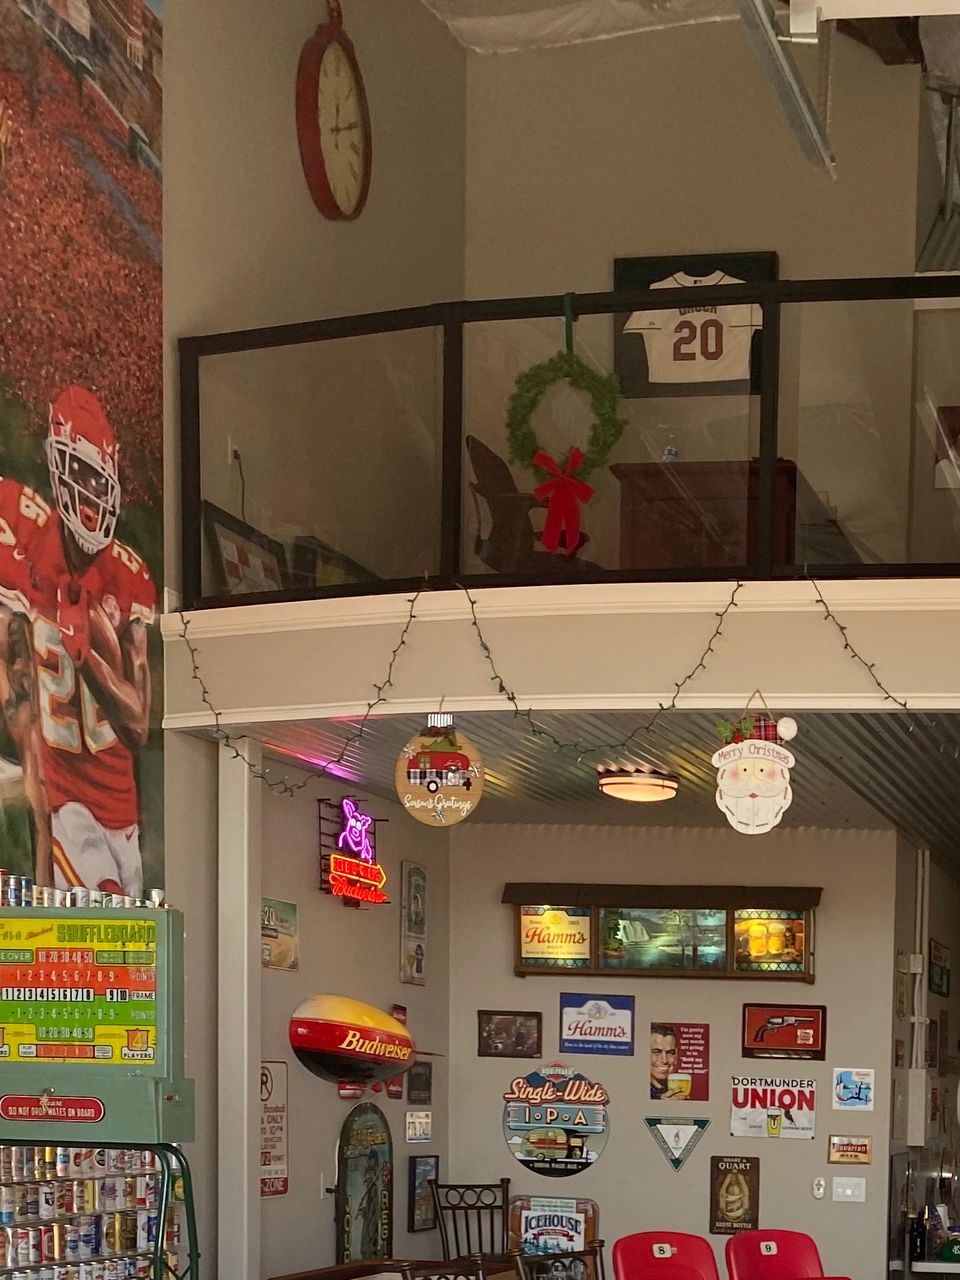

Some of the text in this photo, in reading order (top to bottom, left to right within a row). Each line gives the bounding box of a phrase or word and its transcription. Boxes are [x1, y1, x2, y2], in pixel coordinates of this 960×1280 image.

[673, 319, 723, 361] 20
[718, 743, 790, 765] Merry Christmas
[56, 924, 155, 943] SHUFFLEBOARD
[525, 926, 588, 945] Hamm's
[38, 952, 46, 963] 10
[50, 952, 58, 963] 20
[61, 952, 69, 963] 30
[72, 952, 81, 963] 40
[84, 952, 93, 963] 50
[132, 992, 154, 1000] FRAME
[568, 1020, 626, 1038] Hamm's
[132, 1031, 143, 1047] 4
[339, 1030, 412, 1060] Budweiser
[504, 1078, 606, 1104] Single-Wide
[732, 1078, 814, 1088] DORTMUNDER
[732, 1088, 815, 1111] UNION
[267, 1115, 284, 1124] ONLY
[718, 1162, 752, 1170] QUART
[524, 1214, 582, 1235] ICEHOUSE
[658, 1246, 665, 1255] 8
[765, 1244, 772, 1253] 9
